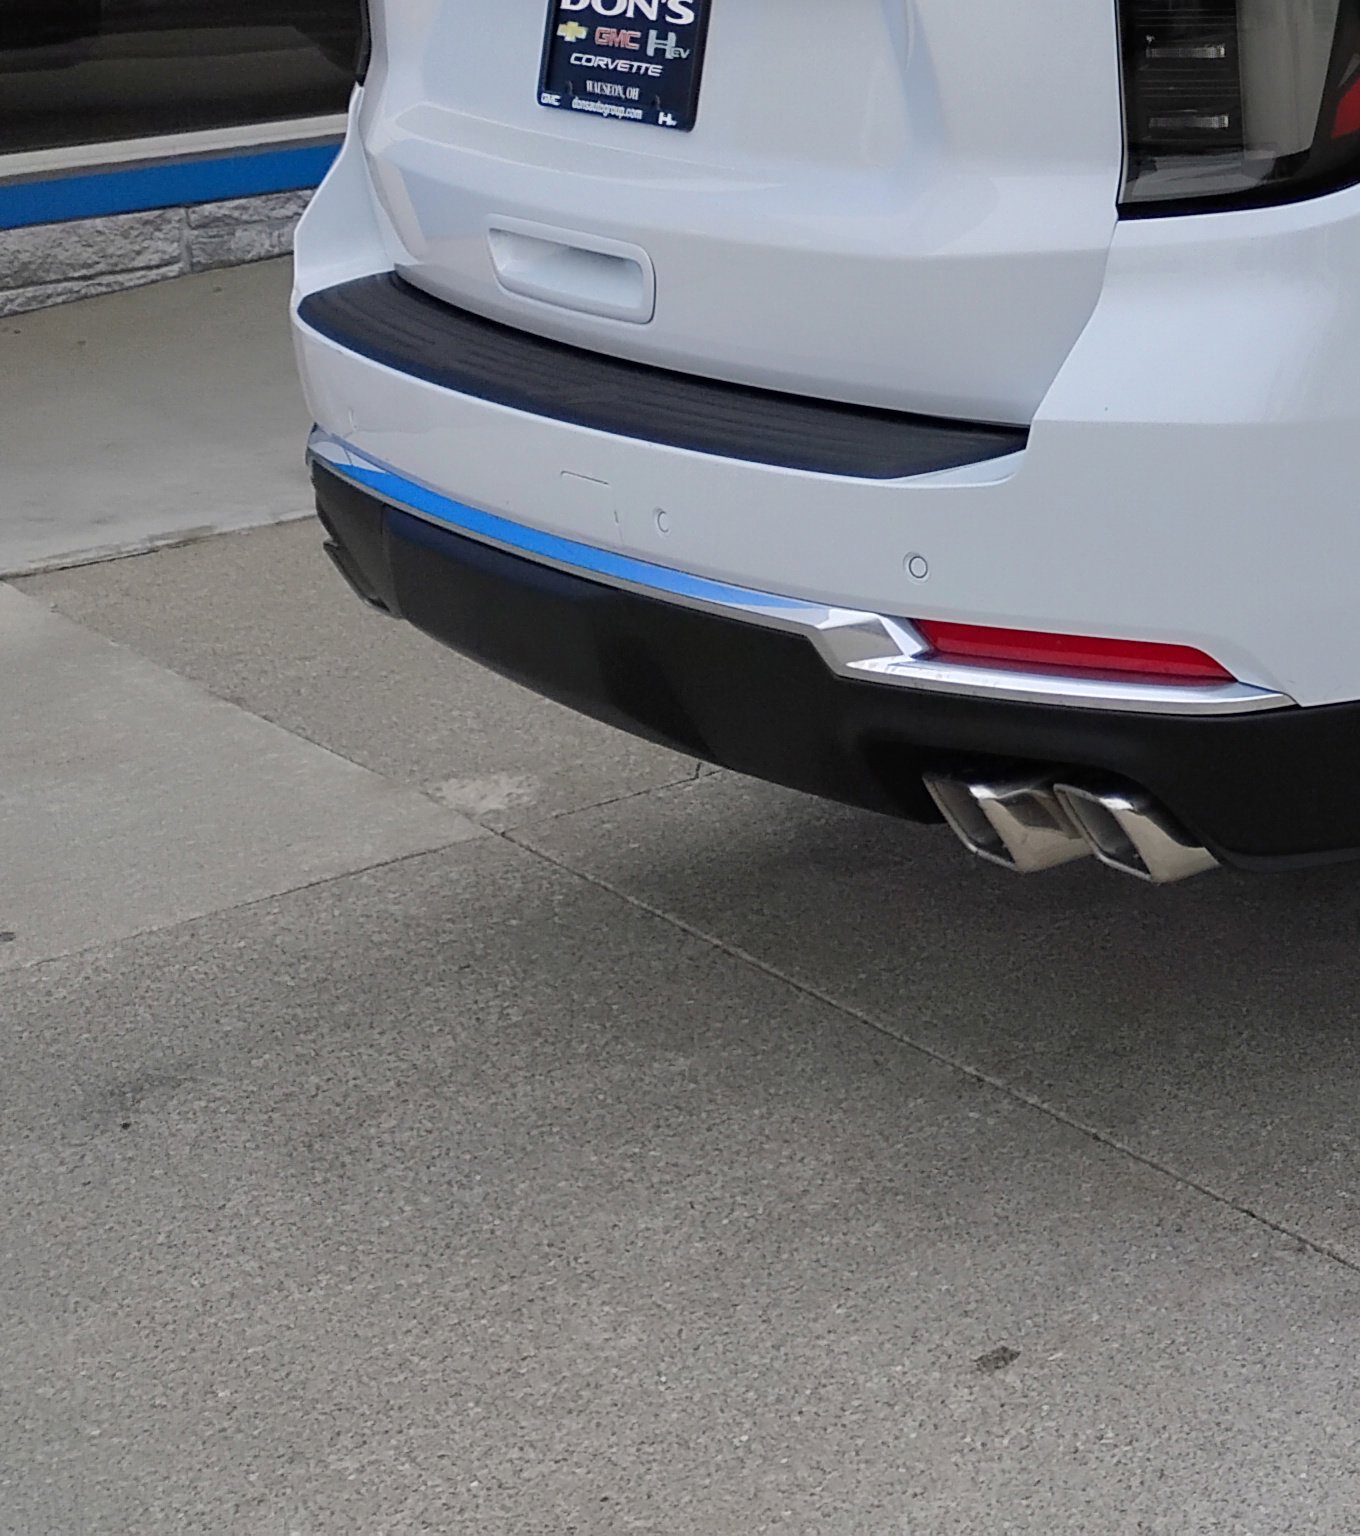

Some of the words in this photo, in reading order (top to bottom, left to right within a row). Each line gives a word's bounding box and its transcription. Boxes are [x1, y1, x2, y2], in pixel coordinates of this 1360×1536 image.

[594, 26, 642, 50] GMC
[569, 53, 664, 77] CORVETTE
[626, 86, 640, 101] OH
